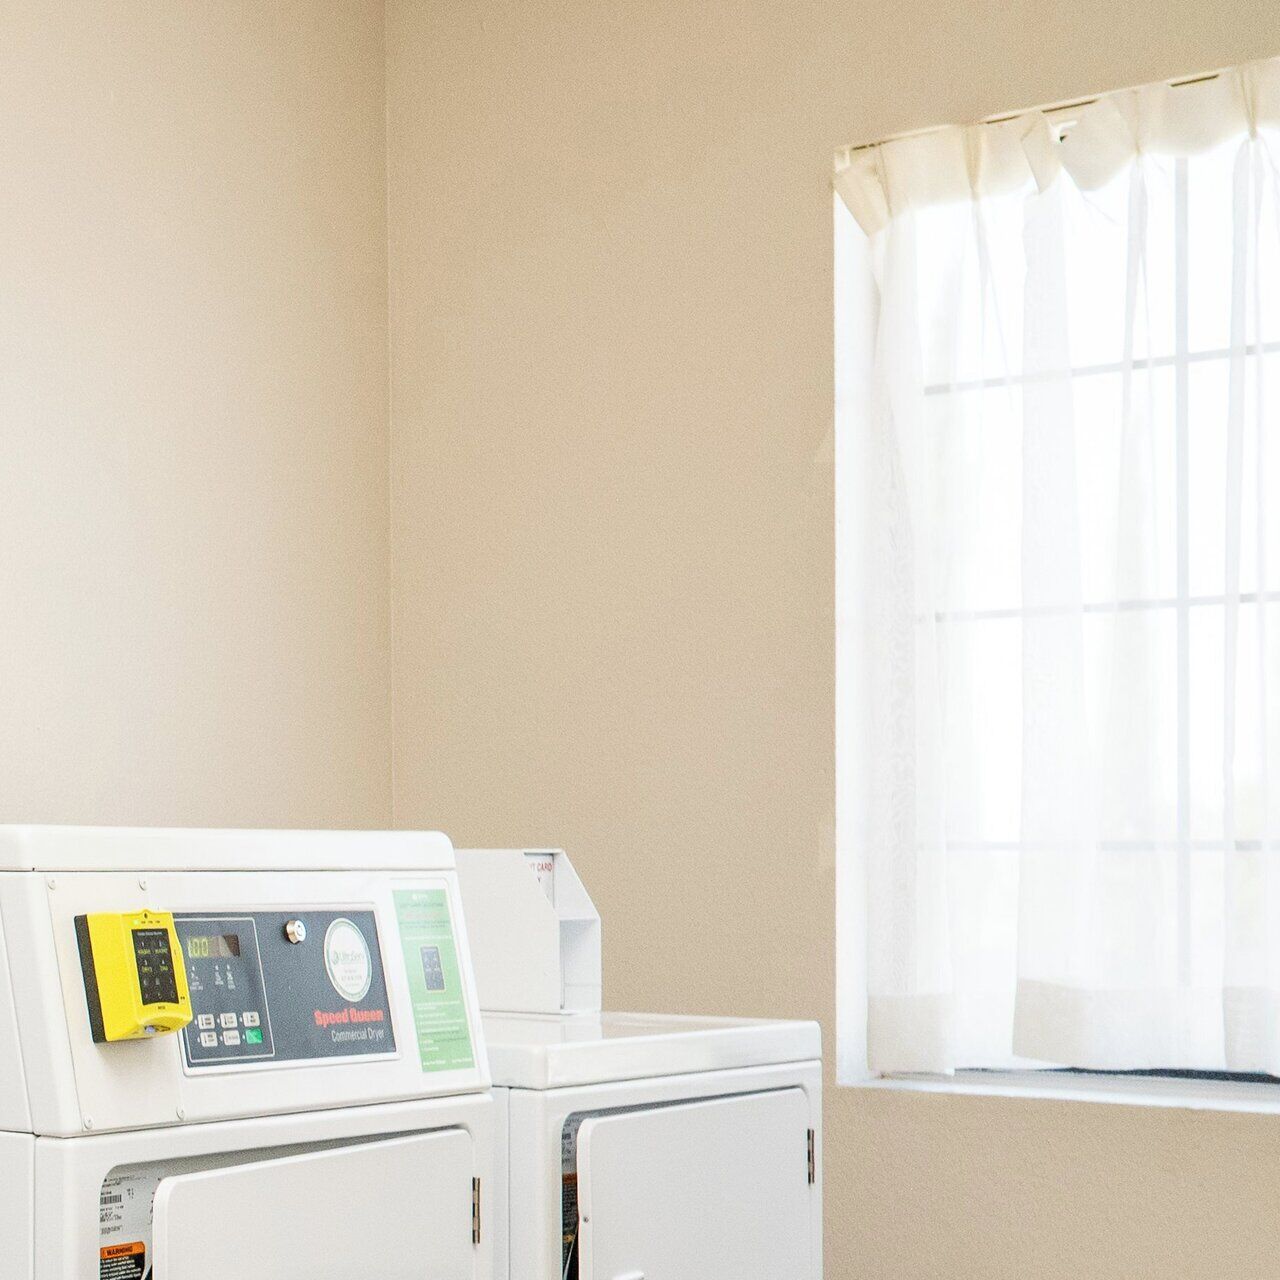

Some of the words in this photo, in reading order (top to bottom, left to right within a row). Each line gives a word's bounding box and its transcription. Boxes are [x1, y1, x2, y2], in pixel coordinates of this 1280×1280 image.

[314, 1008, 348, 1028] Speed
[350, 1008, 384, 1022] Queen
[331, 1029, 367, 1042] Commercial
[368, 1027, 384, 1040] Dryer
[106, 1246, 132, 1256] WARNING
